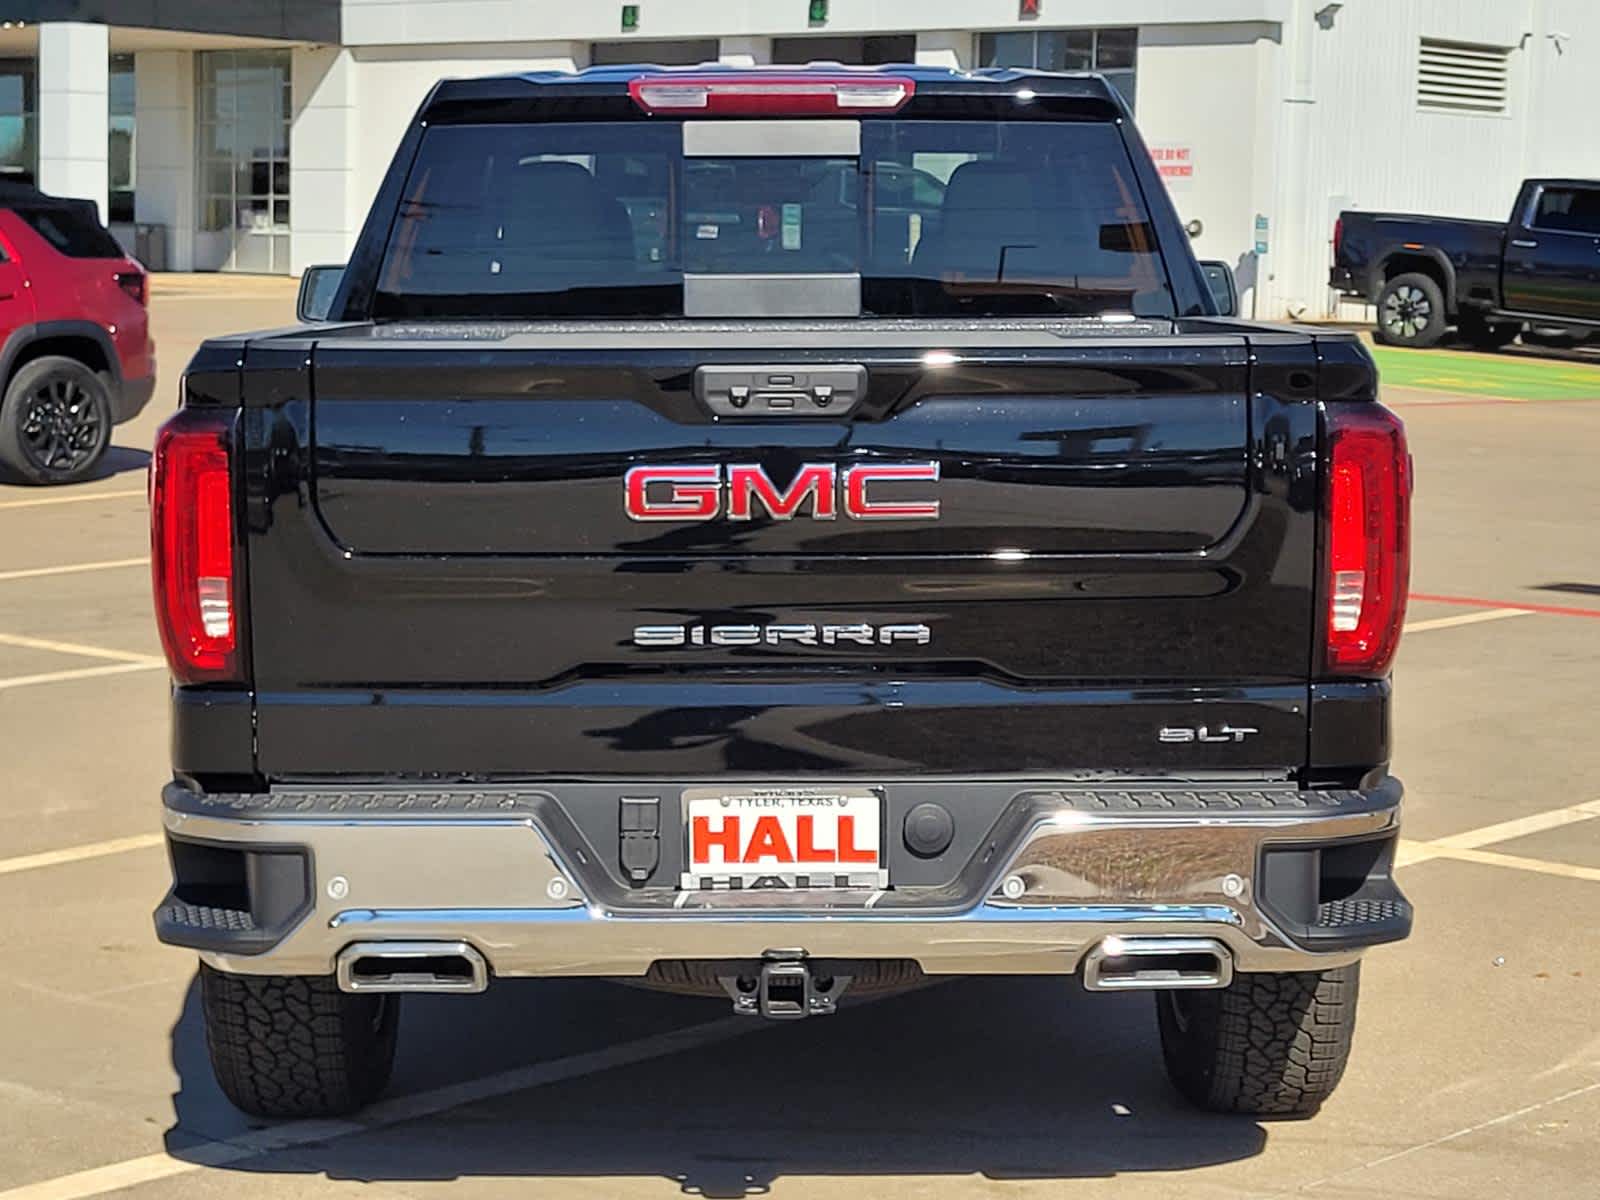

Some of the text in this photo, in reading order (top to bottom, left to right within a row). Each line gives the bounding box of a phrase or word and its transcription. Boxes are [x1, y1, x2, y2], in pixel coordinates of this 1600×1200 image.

[624, 461, 941, 521] GMC
[632, 624, 931, 647] SIERRA
[1159, 725, 1258, 742] SLT
[738, 797, 833, 808] TYLER, TEXAS
[692, 815, 878, 864] HALL
